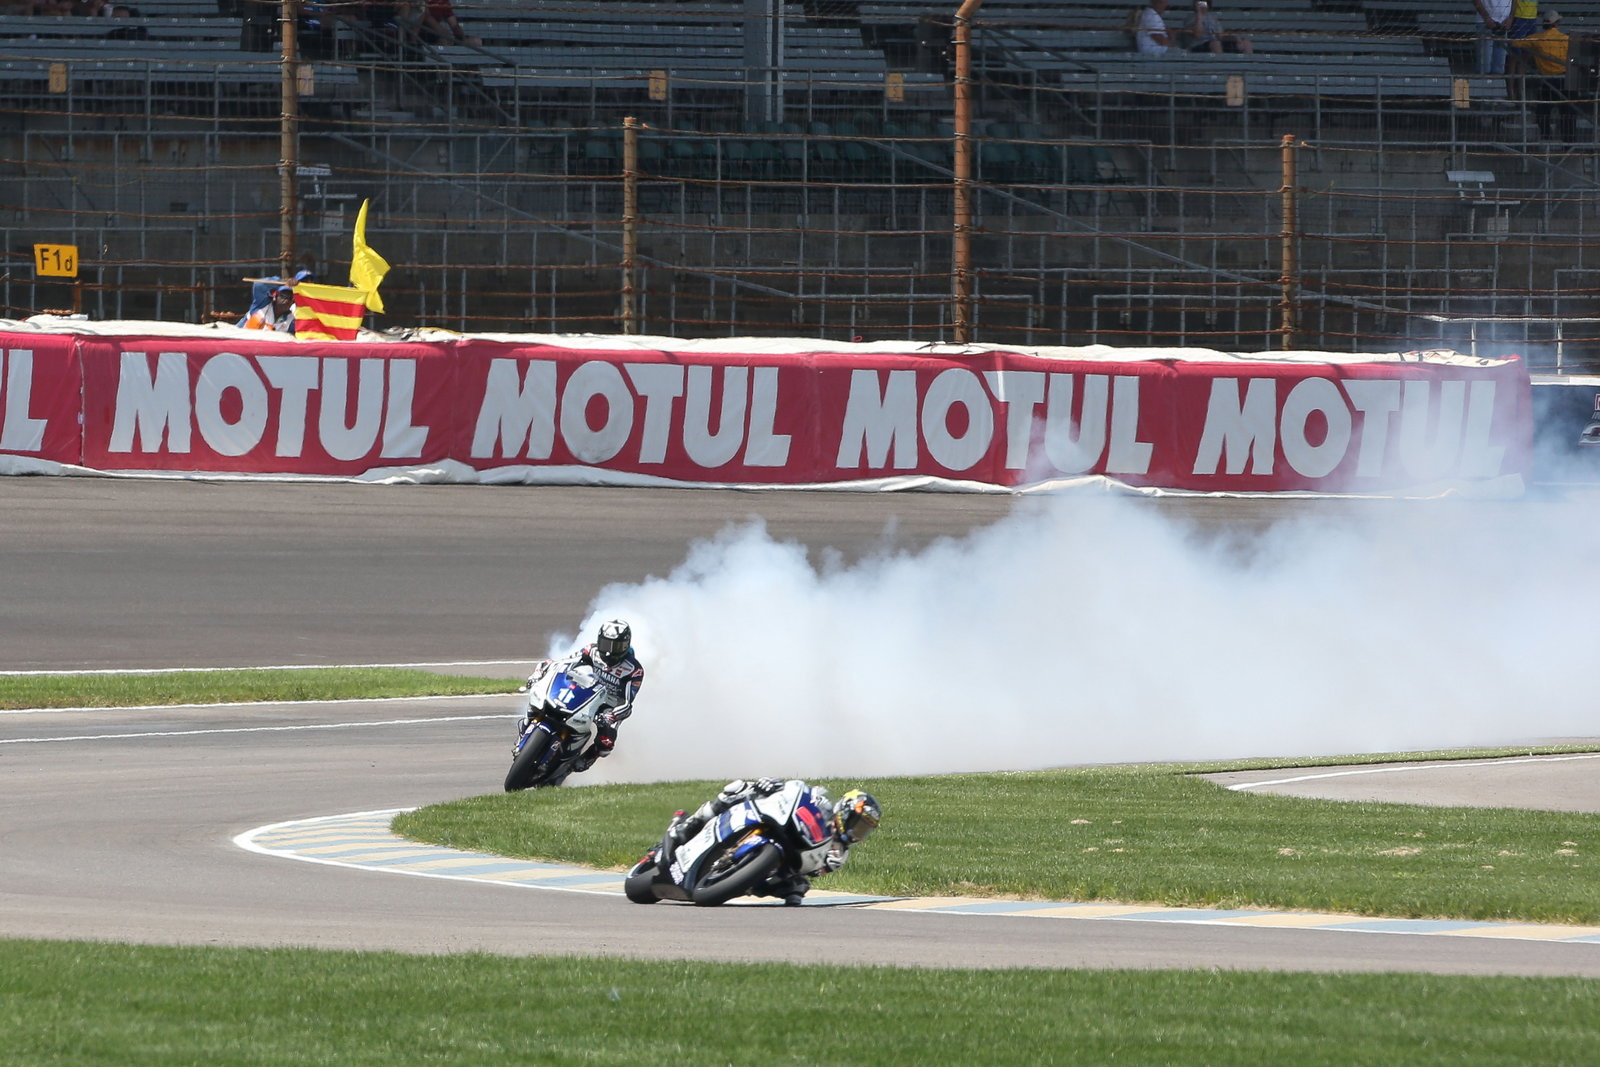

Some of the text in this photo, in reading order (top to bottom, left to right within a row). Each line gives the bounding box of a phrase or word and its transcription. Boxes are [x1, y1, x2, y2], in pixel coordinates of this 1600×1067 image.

[0, 349, 47, 451] L
[108, 352, 429, 461] MOTUL
[471, 358, 792, 468] MOTUL
[836, 368, 1154, 474] MOTUL
[1192, 376, 1507, 478] MOTUL
[593, 666, 621, 686] YAMAHA
